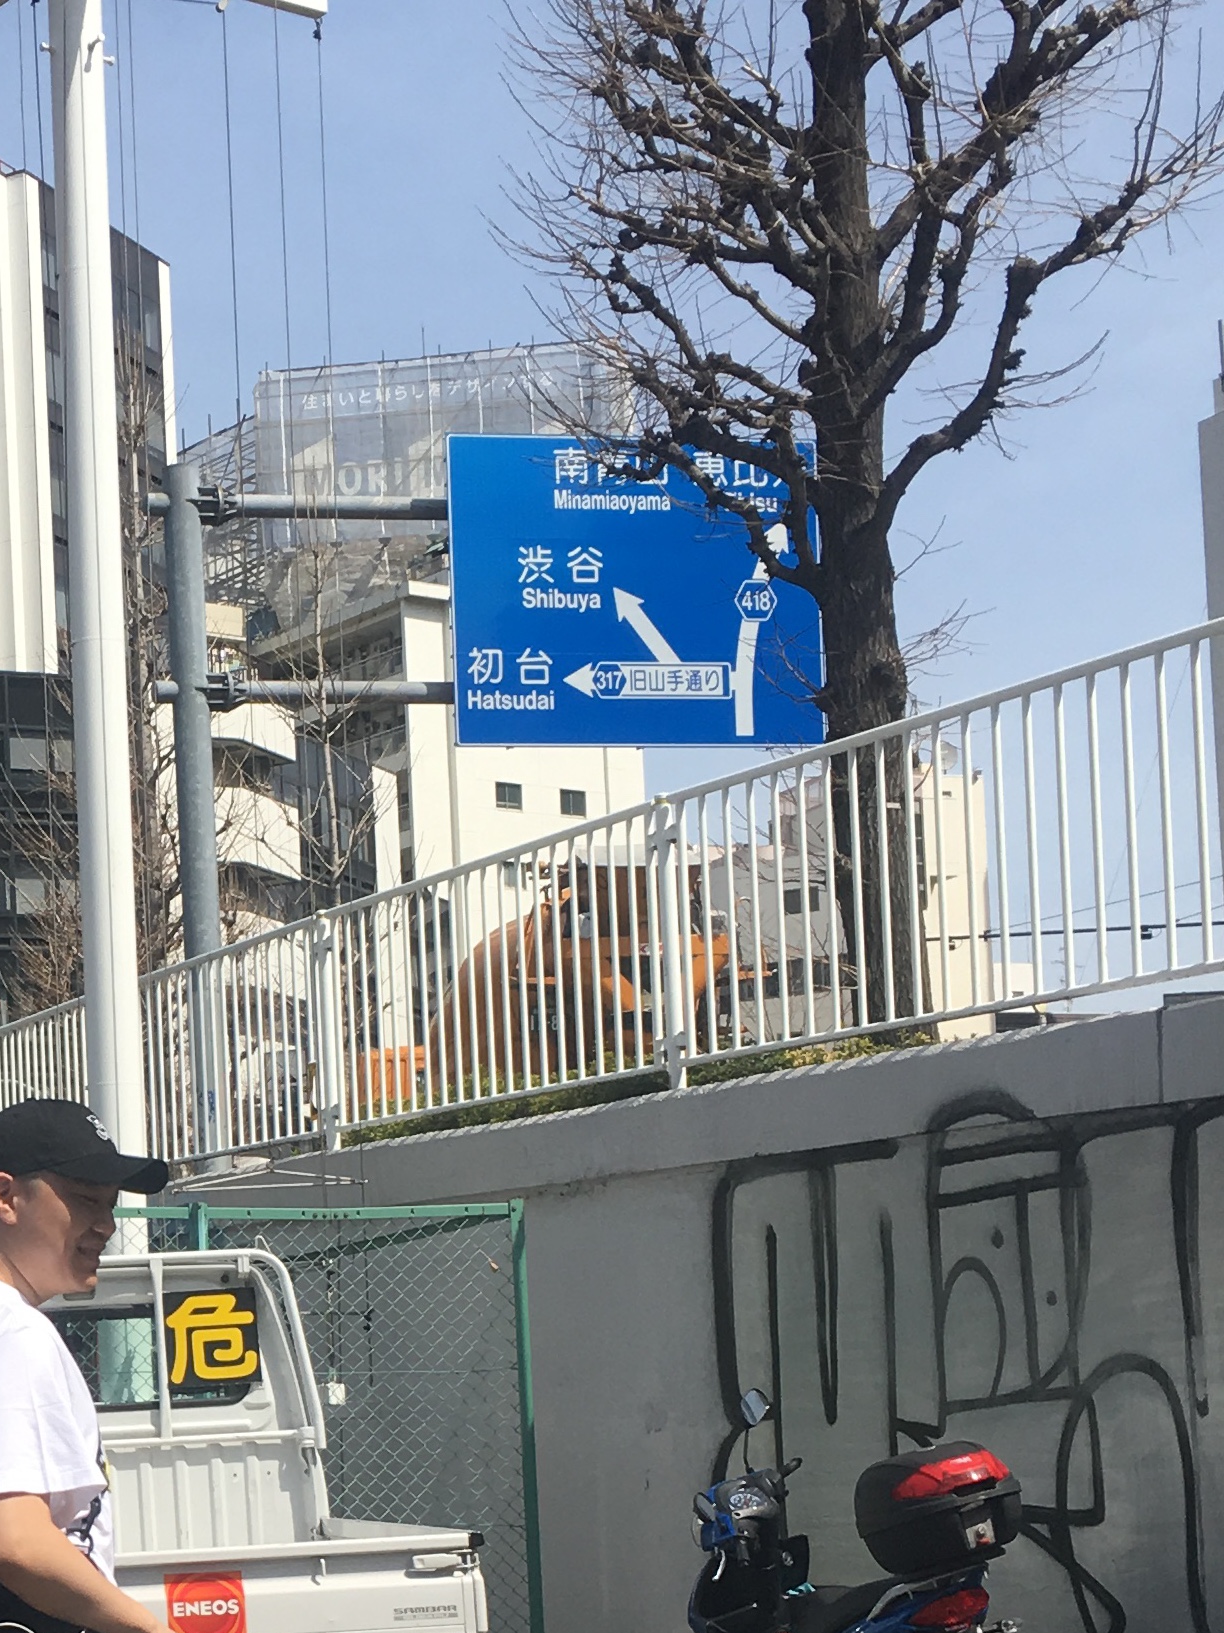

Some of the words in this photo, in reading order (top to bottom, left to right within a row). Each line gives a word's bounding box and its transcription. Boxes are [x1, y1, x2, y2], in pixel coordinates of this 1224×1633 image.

[553, 489, 671, 515] Minamiaoyama
[517, 545, 604, 584] 渋谷
[522, 588, 601, 613] Shibuya
[740, 590, 772, 612] 418
[467, 647, 553, 686] 初台
[596, 673, 624, 692] 317
[629, 667, 721, 693] 旧山手通り
[467, 689, 556, 711] Hatsudai
[166, 1293, 259, 1384] 危
[172, 1599, 240, 1618] ENEOS
